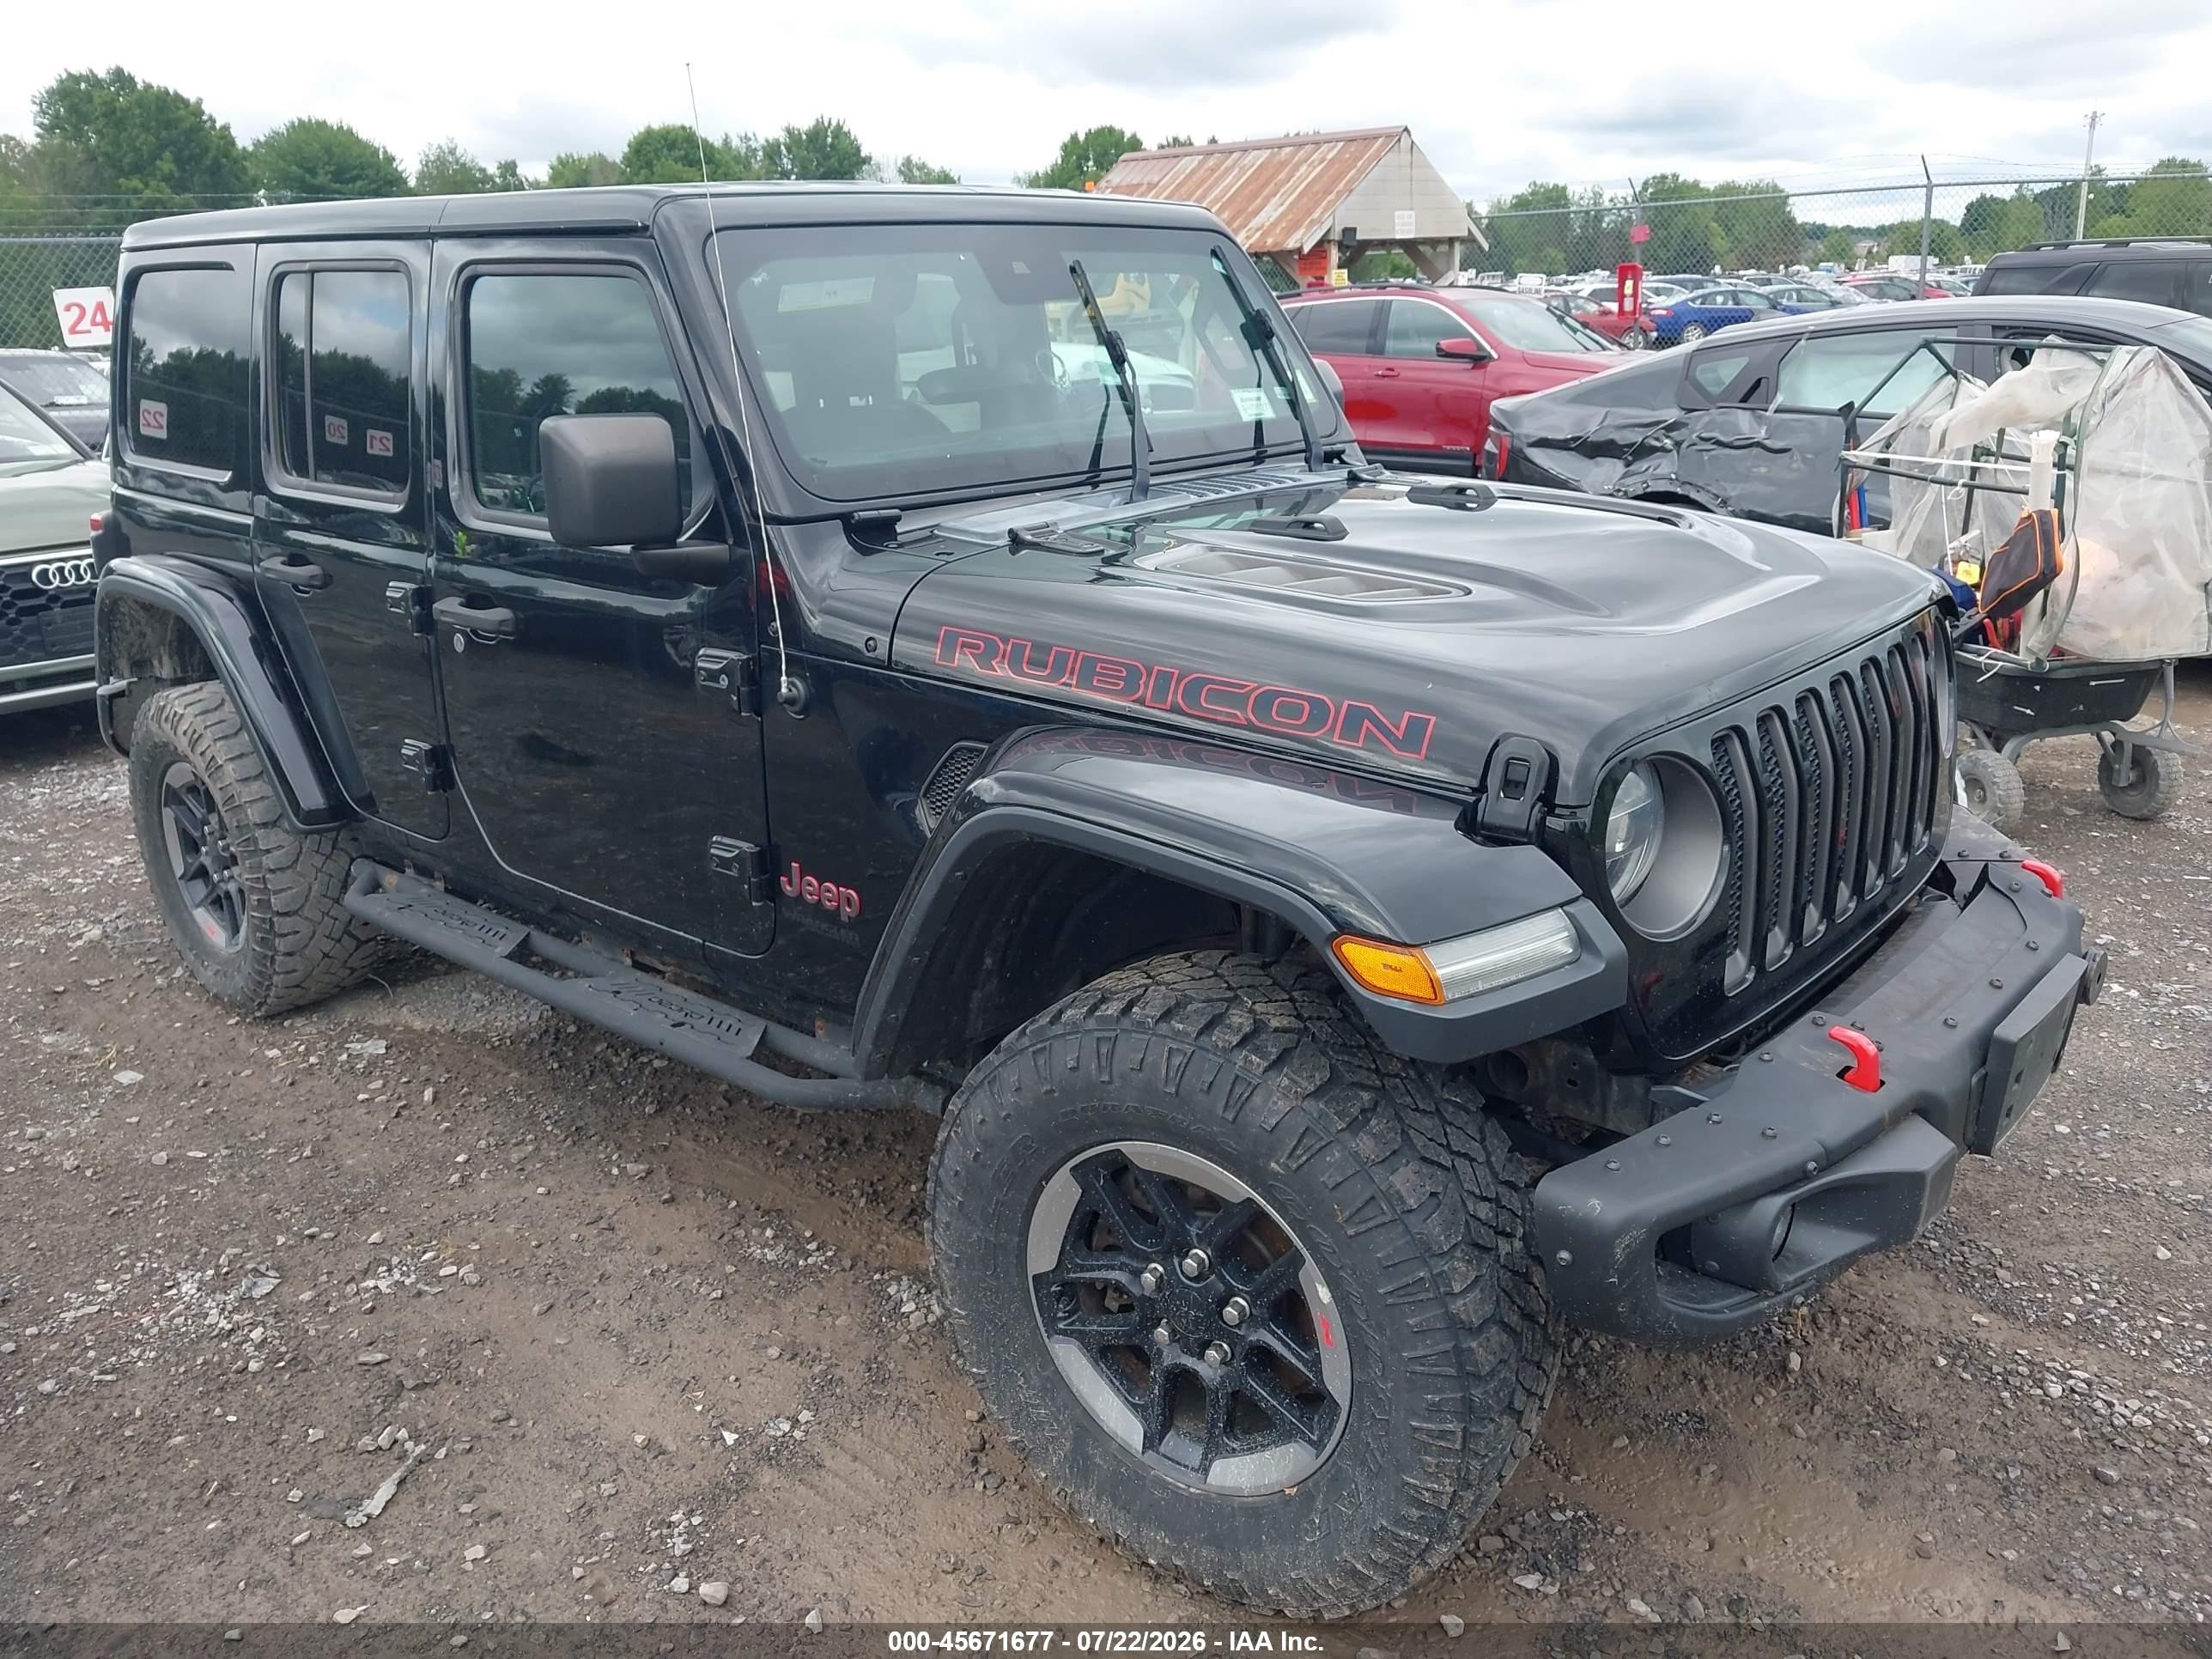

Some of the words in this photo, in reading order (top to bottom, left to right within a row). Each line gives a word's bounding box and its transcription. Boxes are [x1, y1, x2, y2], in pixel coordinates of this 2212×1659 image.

[64, 301, 113, 335] 24
[936, 625, 1436, 759] RUBICON
[779, 861, 860, 923] Jeep
